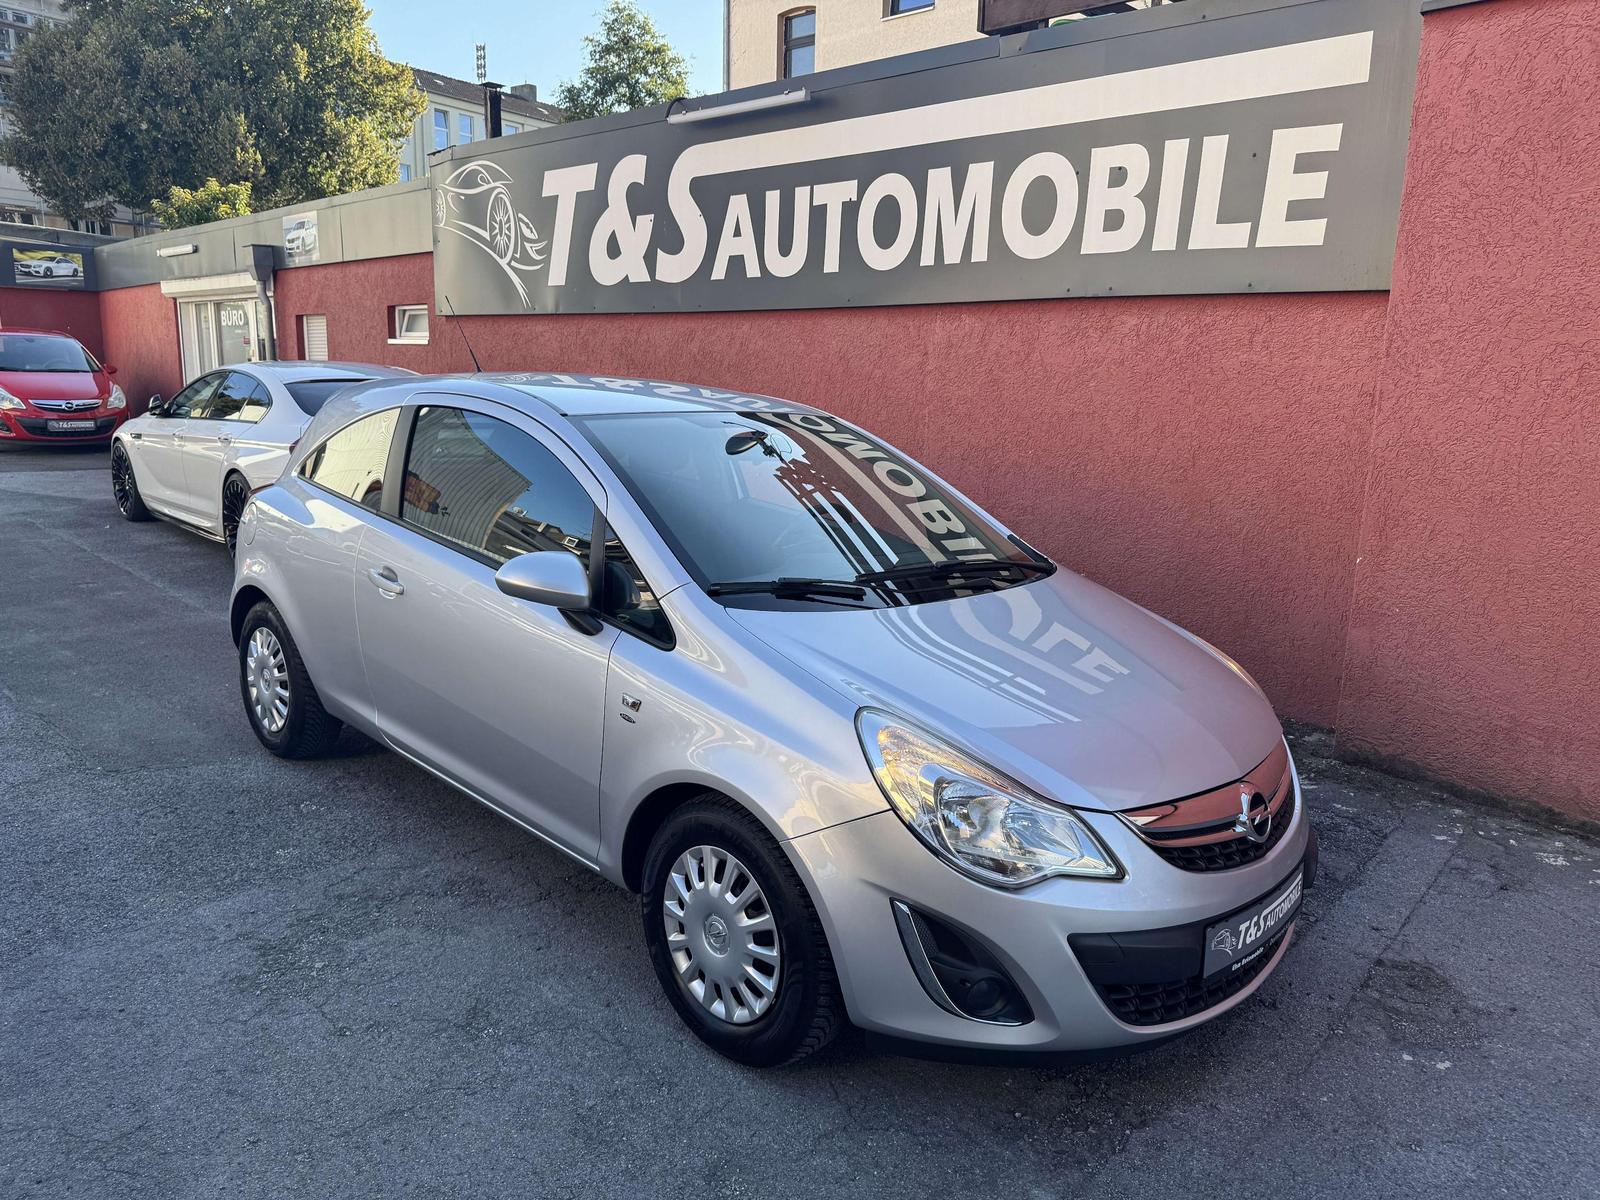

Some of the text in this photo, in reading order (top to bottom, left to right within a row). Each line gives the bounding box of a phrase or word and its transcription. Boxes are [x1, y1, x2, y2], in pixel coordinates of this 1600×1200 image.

[541, 122, 1343, 286] T&S AUTOMOBILE
[221, 307, 244, 326] BÜRO
[1238, 911, 1265, 950] T&S
[1264, 880, 1302, 931] AUTOMOBILE
